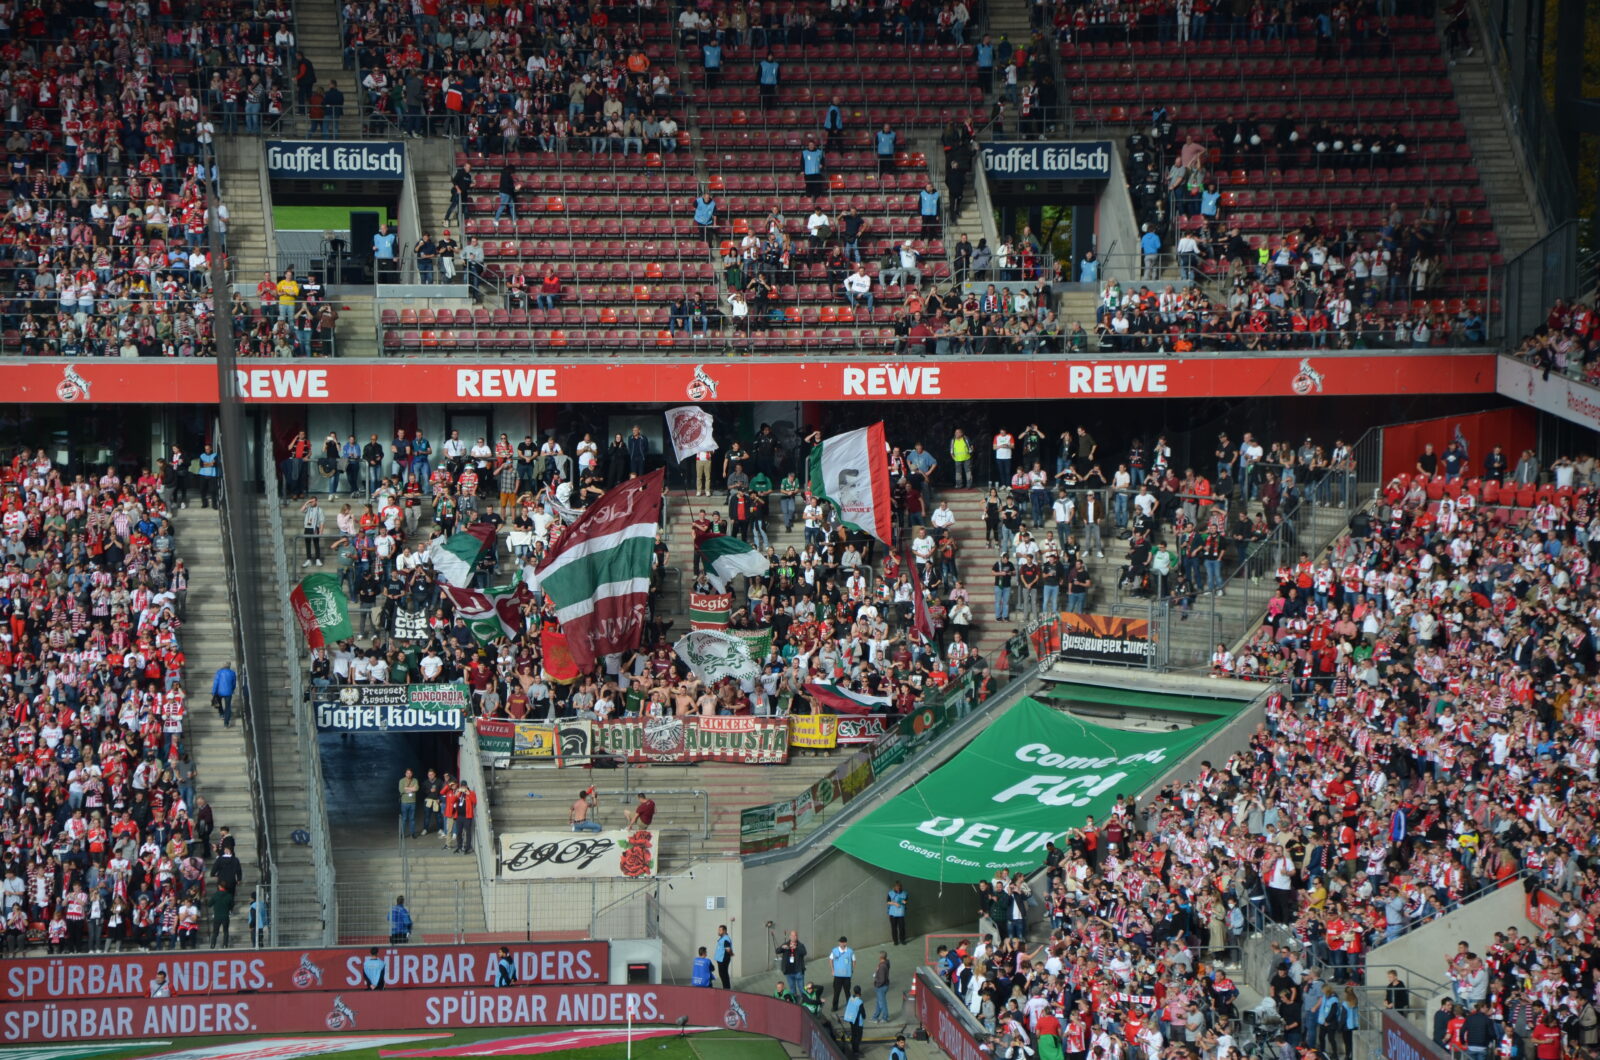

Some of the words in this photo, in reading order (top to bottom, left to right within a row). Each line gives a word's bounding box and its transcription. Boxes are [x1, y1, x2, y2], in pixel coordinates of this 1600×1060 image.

[268, 146, 330, 173] Gaffel
[333, 147, 402, 175] Kölsch
[982, 147, 1040, 173] Gaffel
[1043, 147, 1108, 175] Kölsch
[232, 369, 328, 398] REWE
[456, 369, 557, 397] REWE
[843, 367, 941, 395] REWE
[1069, 365, 1167, 393] REWE
[690, 593, 729, 610] Legio
[394, 628, 429, 639] DIA
[411, 691, 464, 702] CONCORDIA
[700, 717, 755, 730] KICKERS
[685, 729, 789, 751] AUGUSTA
[1015, 744, 1118, 769] Come
[992, 772, 1129, 807] FC!
[915, 816, 1067, 853] DEVK
[502, 837, 616, 872] 1907
[899, 840, 942, 860] Gesagt.
[946, 855, 981, 868] Getan.
[8, 960, 144, 997] SPÜRBAR
[347, 950, 475, 986] SÜRBAR
[485, 950, 600, 984] ADERS.
[4, 1004, 135, 1040] SPÜRBAR
[143, 1002, 257, 1035] ANDERS.
[426, 991, 547, 1026] SPÜRBAR
[556, 992, 665, 1025] ANDERS.
